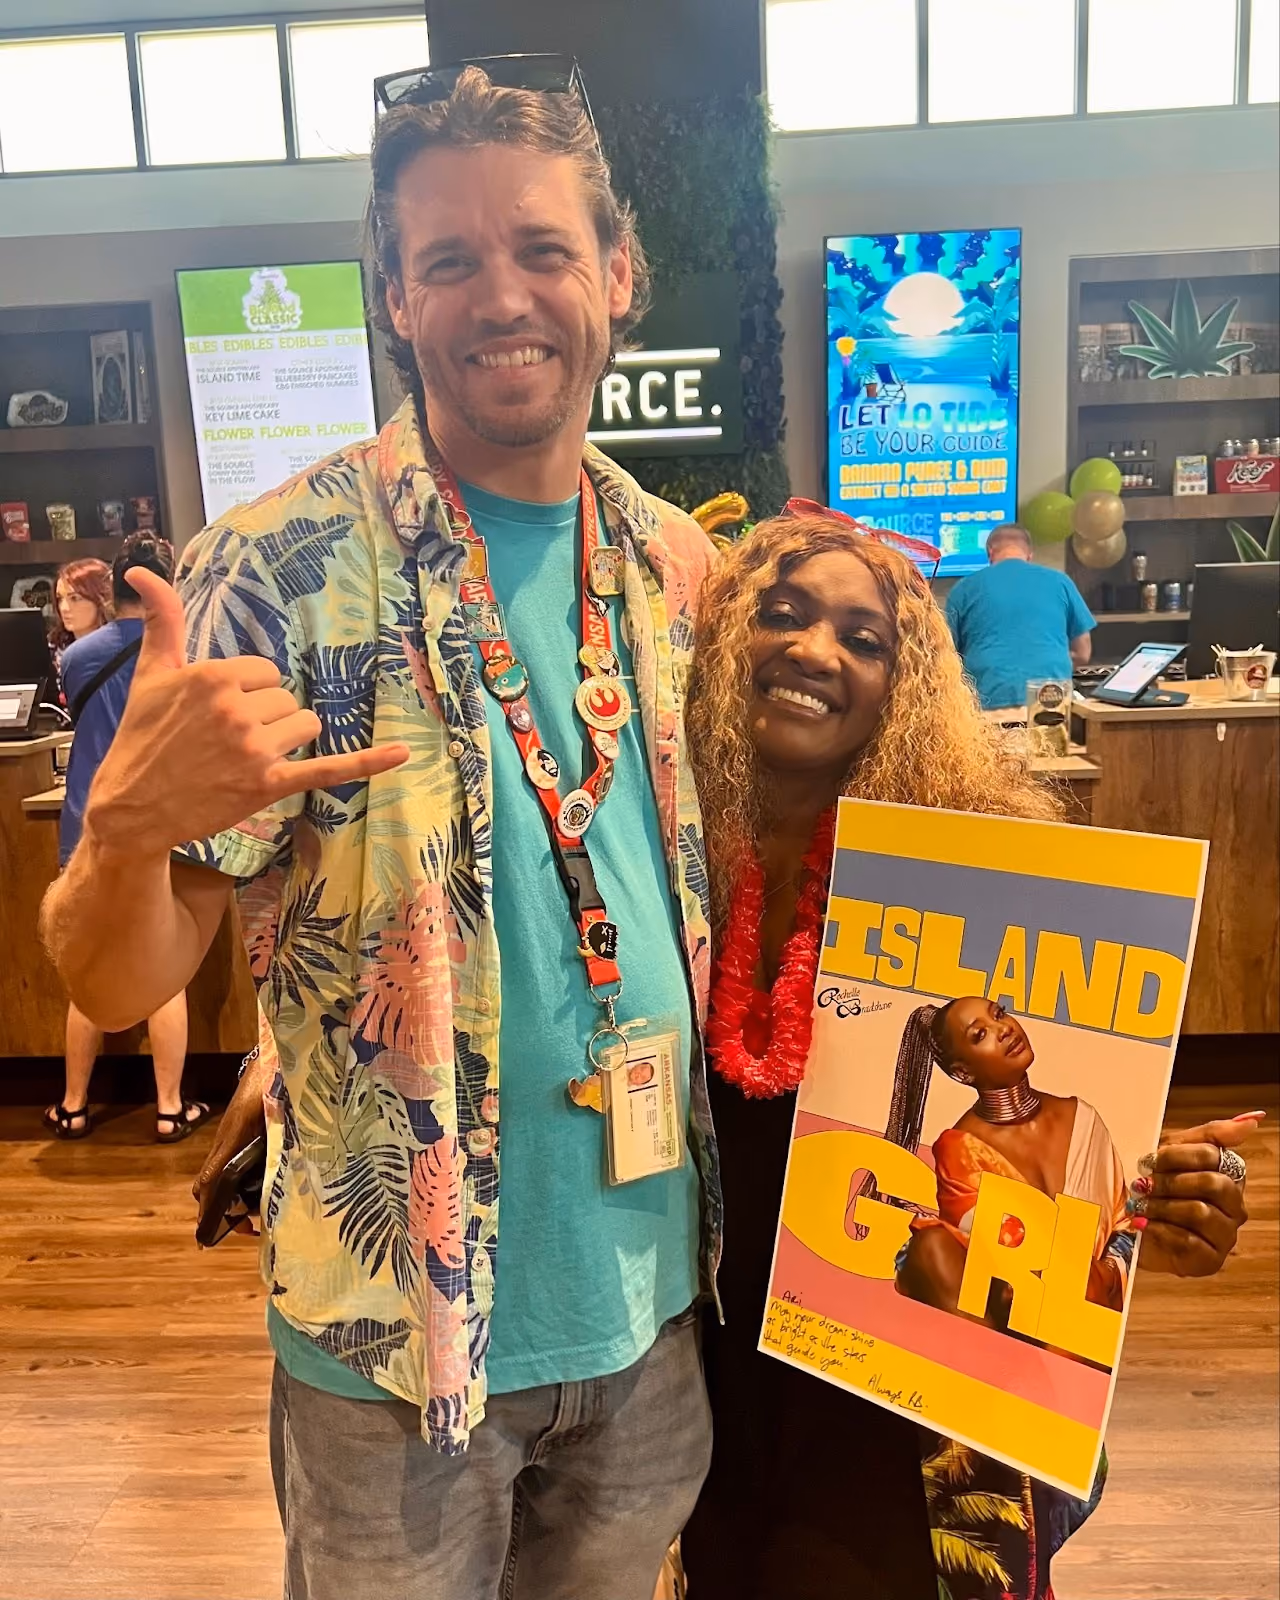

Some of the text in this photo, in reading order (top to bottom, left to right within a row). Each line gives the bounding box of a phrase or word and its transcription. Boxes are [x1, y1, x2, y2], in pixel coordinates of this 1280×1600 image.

[250, 313, 298, 326] CLASSIC
[223, 338, 273, 353] EDIBLES
[279, 335, 328, 349] EDIBLES
[196, 371, 261, 384] ISLAND TIME
[205, 409, 280, 422] KEY LIME CAKE
[841, 404, 891, 431] LET
[940, 399, 1008, 433] TIDE
[204, 422, 367, 441] FLOWER FLOWER FLOWER
[841, 431, 1008, 456] BE YOUR GUIDE
[819, 896, 1185, 1039] ISLAND
[663, 1053, 672, 1106] ARKANSAS
[780, 1322, 806, 1342] bright
[786, 1343, 816, 1361] guide
